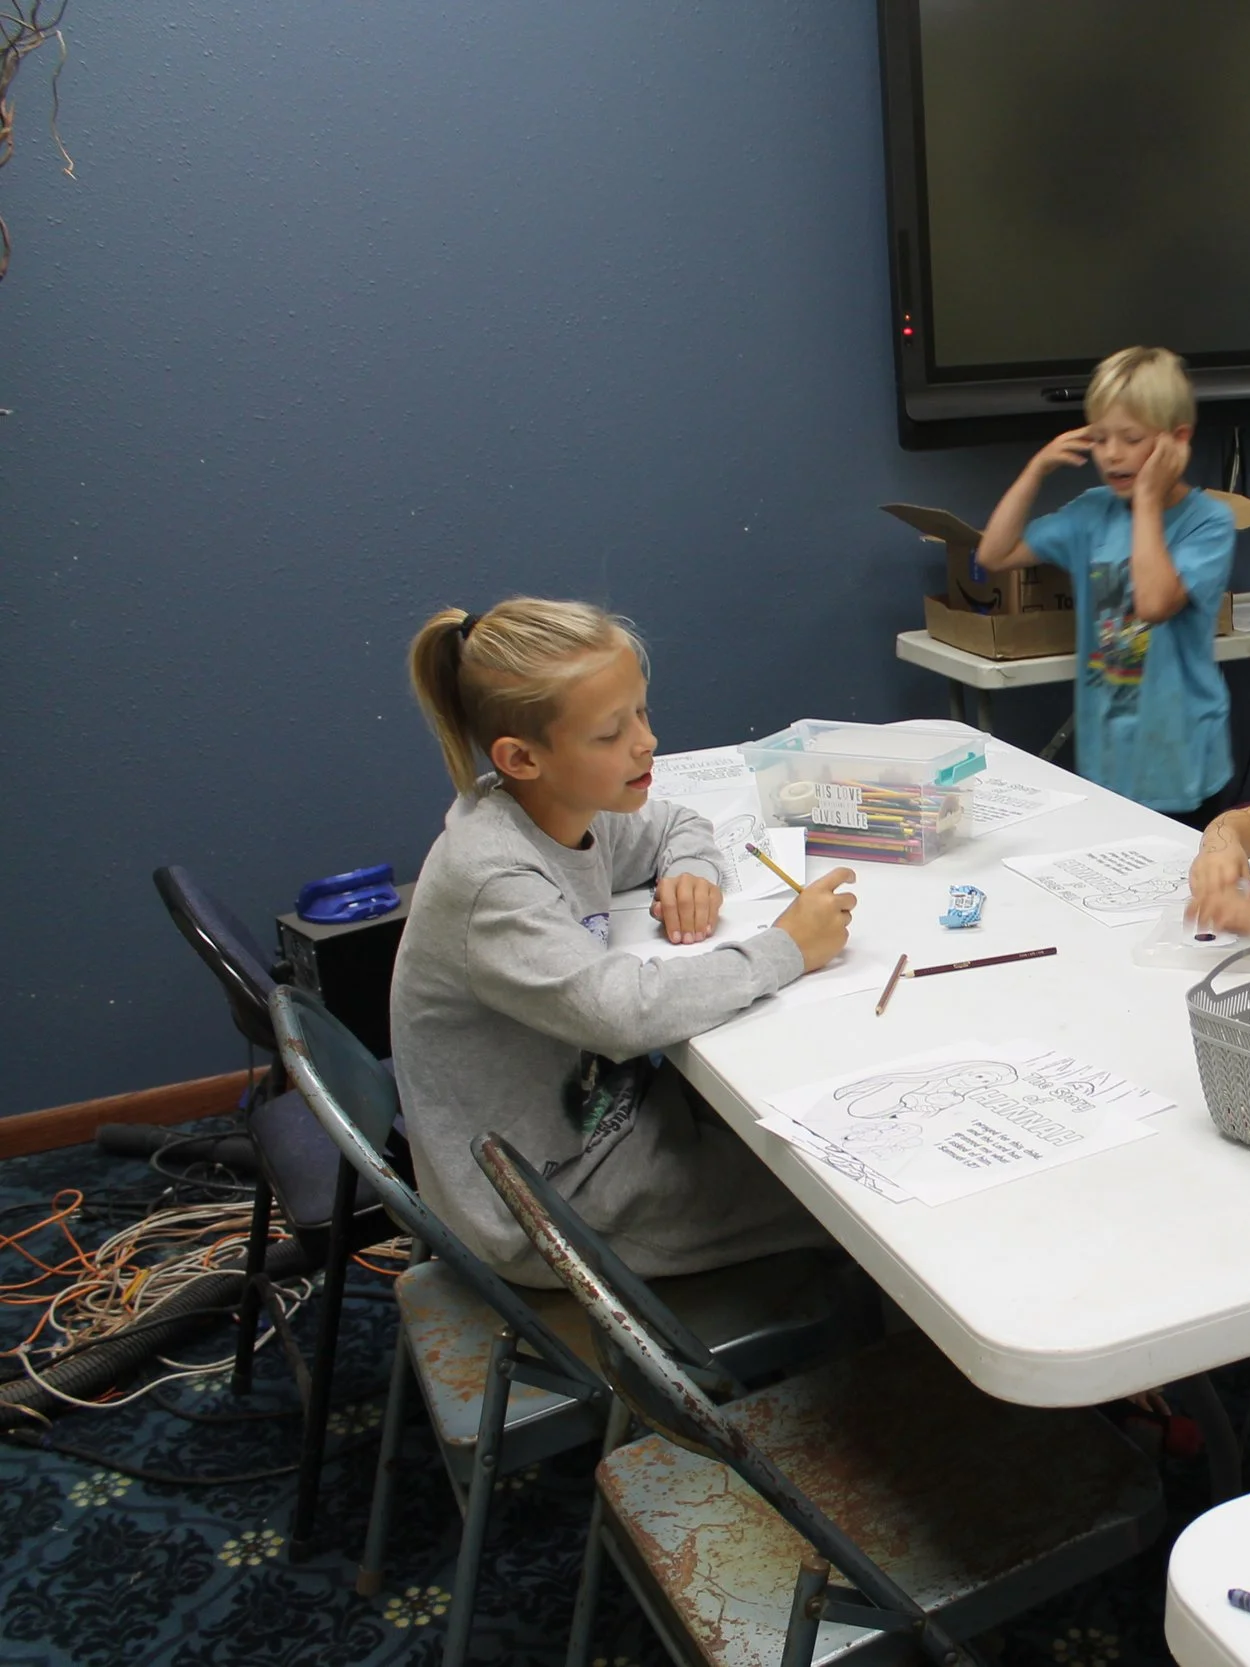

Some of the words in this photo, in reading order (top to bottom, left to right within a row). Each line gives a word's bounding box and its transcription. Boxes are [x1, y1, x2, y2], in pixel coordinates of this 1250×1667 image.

[815, 784, 832, 798] HIS
[837, 787, 862, 802] LOVE
[813, 808, 841, 824] GIVES
[846, 811, 868, 828] LIFE
[1022, 1072, 1054, 1090] The
[1049, 1087, 1096, 1113] Story
[968, 1089, 1085, 1147] HANNAH
